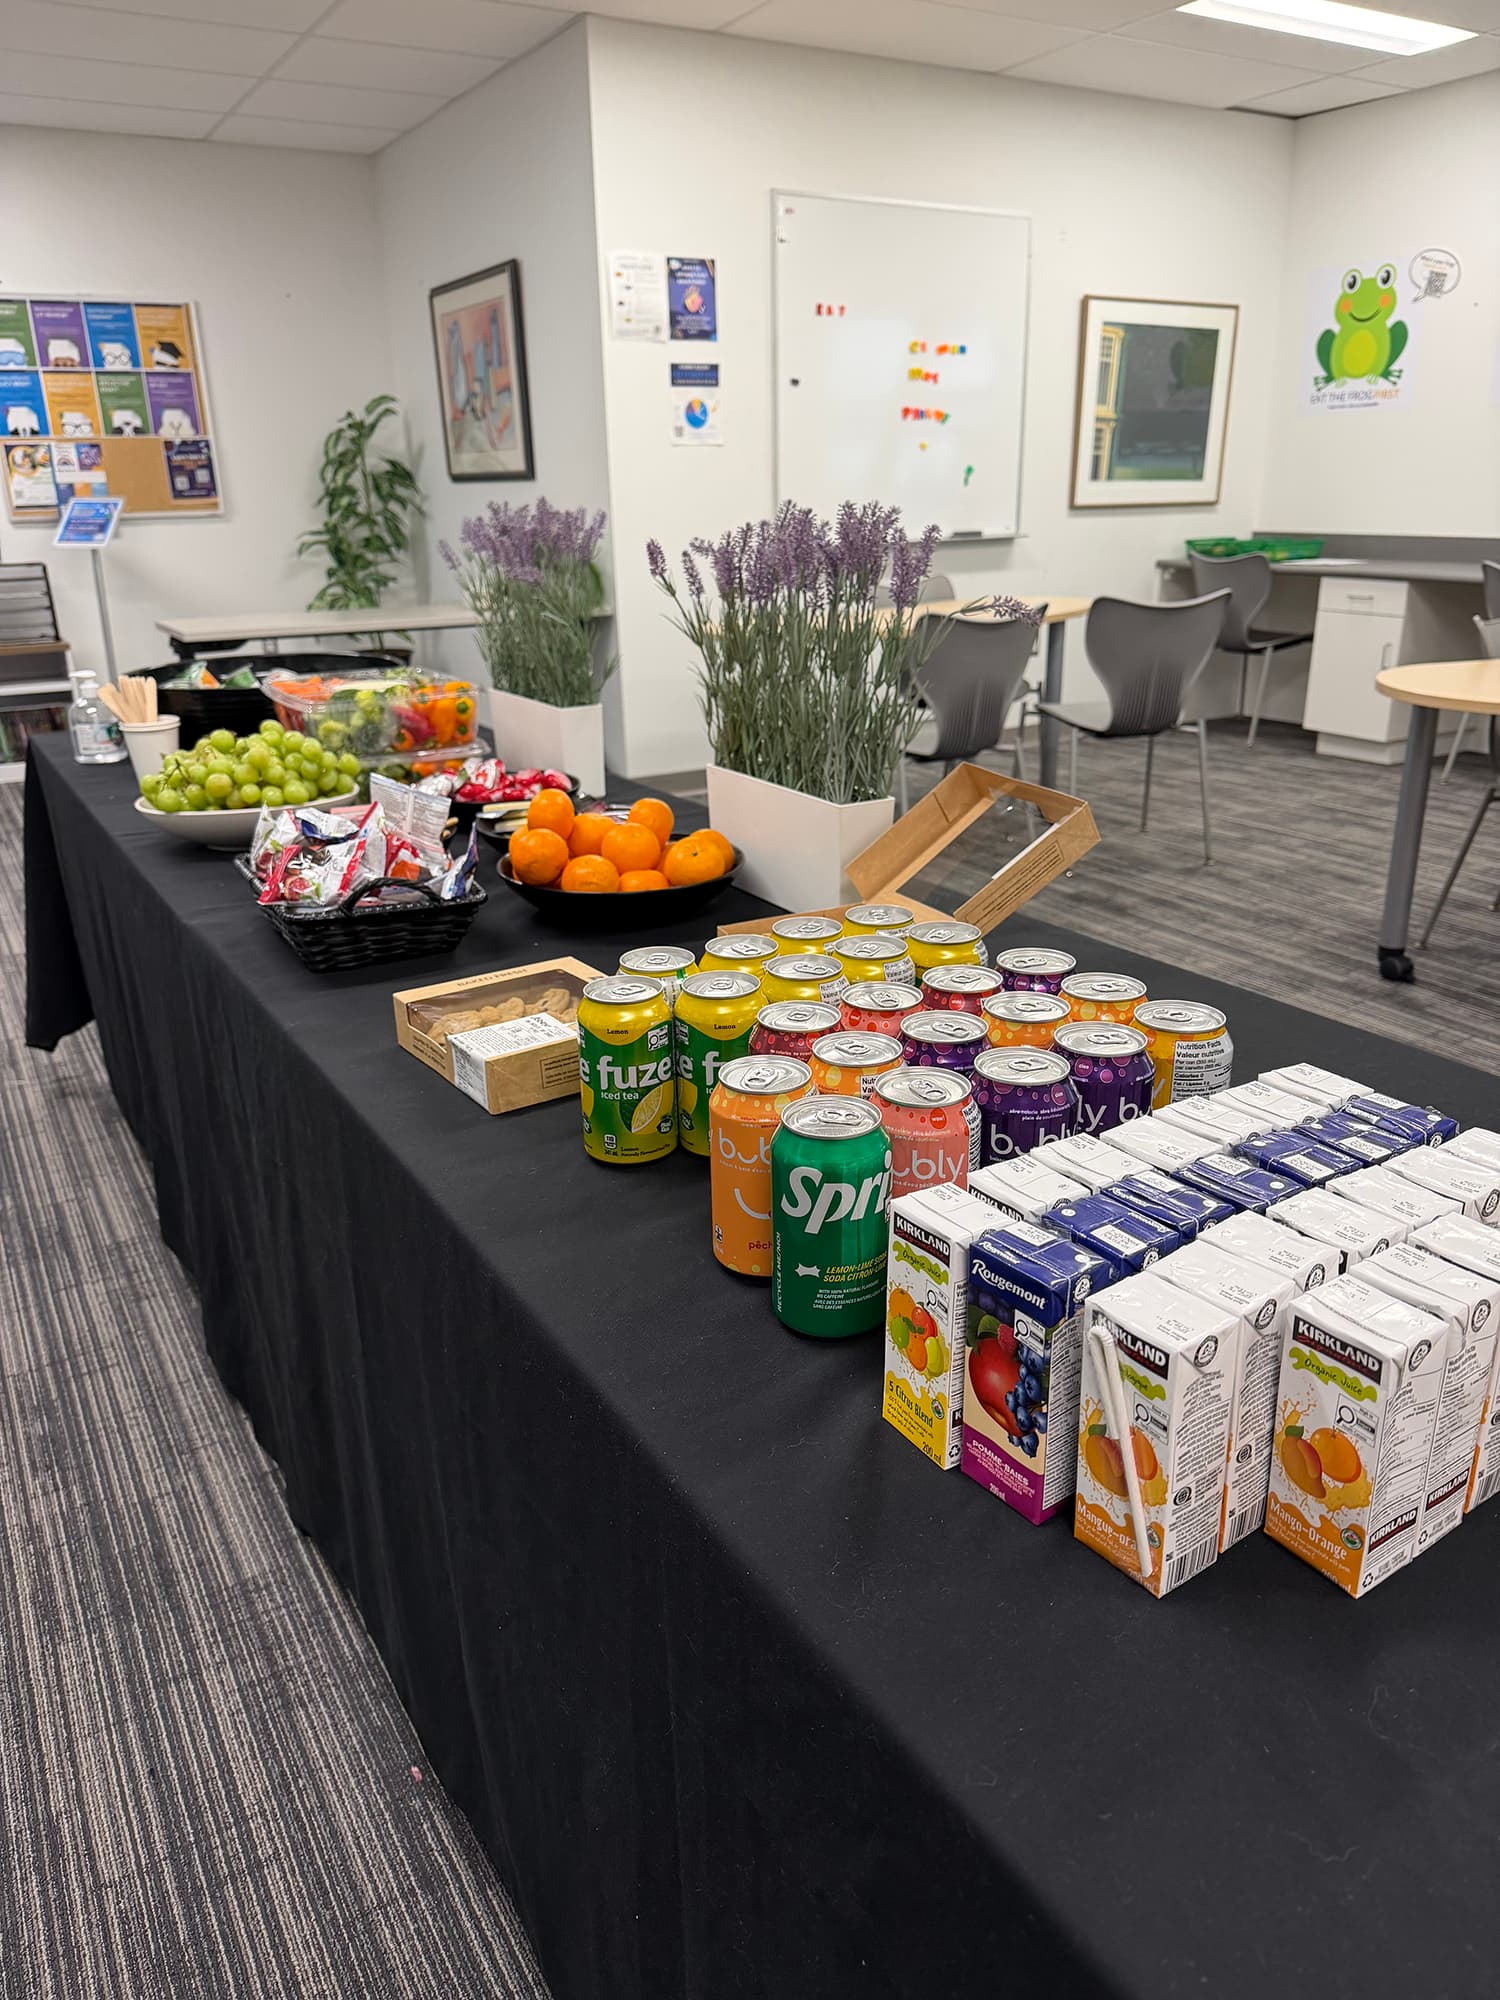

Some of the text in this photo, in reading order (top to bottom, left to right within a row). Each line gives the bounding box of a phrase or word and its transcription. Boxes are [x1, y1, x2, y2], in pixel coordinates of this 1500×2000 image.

[1177, 1040, 1221, 1050] Nutrition Facts
[597, 1055, 672, 1091] fuze
[622, 1091, 639, 1100] tea
[892, 1149, 965, 1184] ubly
[780, 1149, 893, 1235] Spri
[895, 1215, 950, 1257] KIRKLAND
[823, 1274, 846, 1282] SODA
[826, 1258, 875, 1274] LEMON-LIME
[971, 1259, 1049, 1310] Rougemont
[1298, 1321, 1380, 1372] KIRKLAND
[1304, 1358, 1363, 1395] Organic Juice
[889, 1380, 894, 1392] 5
[895, 1384, 913, 1411] Citrus
[914, 1402, 933, 1428] Blend
[1428, 1468, 1469, 1503] KIRKLAND
[1270, 1498, 1348, 1560] Mango-Orange
[1370, 1510, 1417, 1545] KIRKLAND
